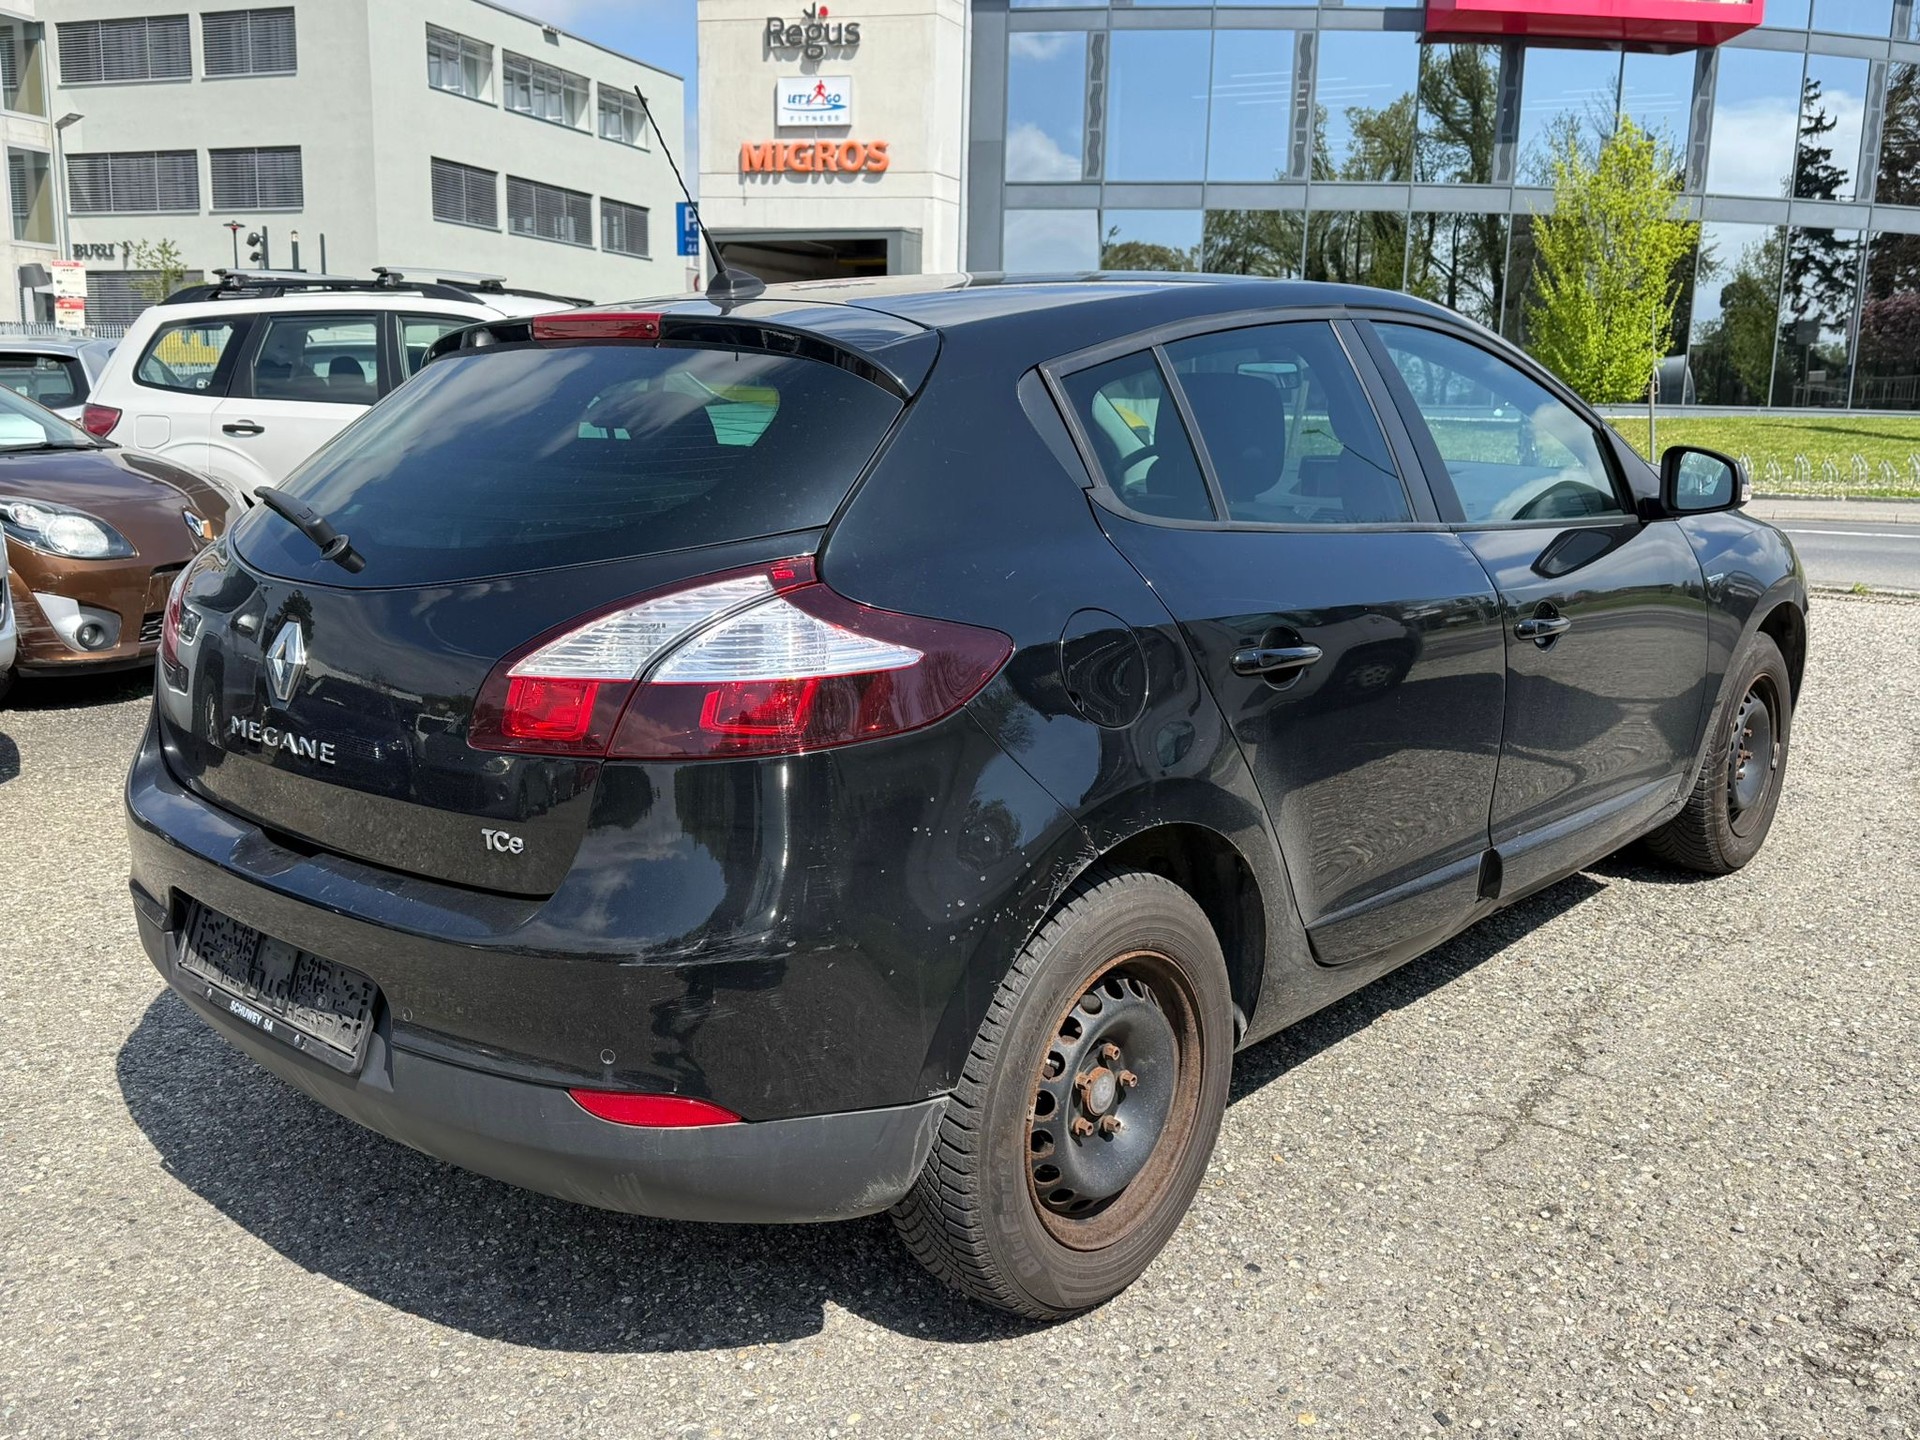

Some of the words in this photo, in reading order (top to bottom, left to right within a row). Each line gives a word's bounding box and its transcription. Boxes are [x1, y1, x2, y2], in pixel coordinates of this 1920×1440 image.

[767, 17, 860, 60] Regus
[788, 94, 811, 105] LET'S
[825, 94, 841, 104] GO
[742, 140, 890, 172] MIGROS
[72, 243, 115, 258] BURRI
[230, 714, 336, 765] MEGANE
[481, 828, 524, 854] TCe
[229, 1000, 263, 1025] SCHUWEY
[263, 1018, 274, 1033] SA
